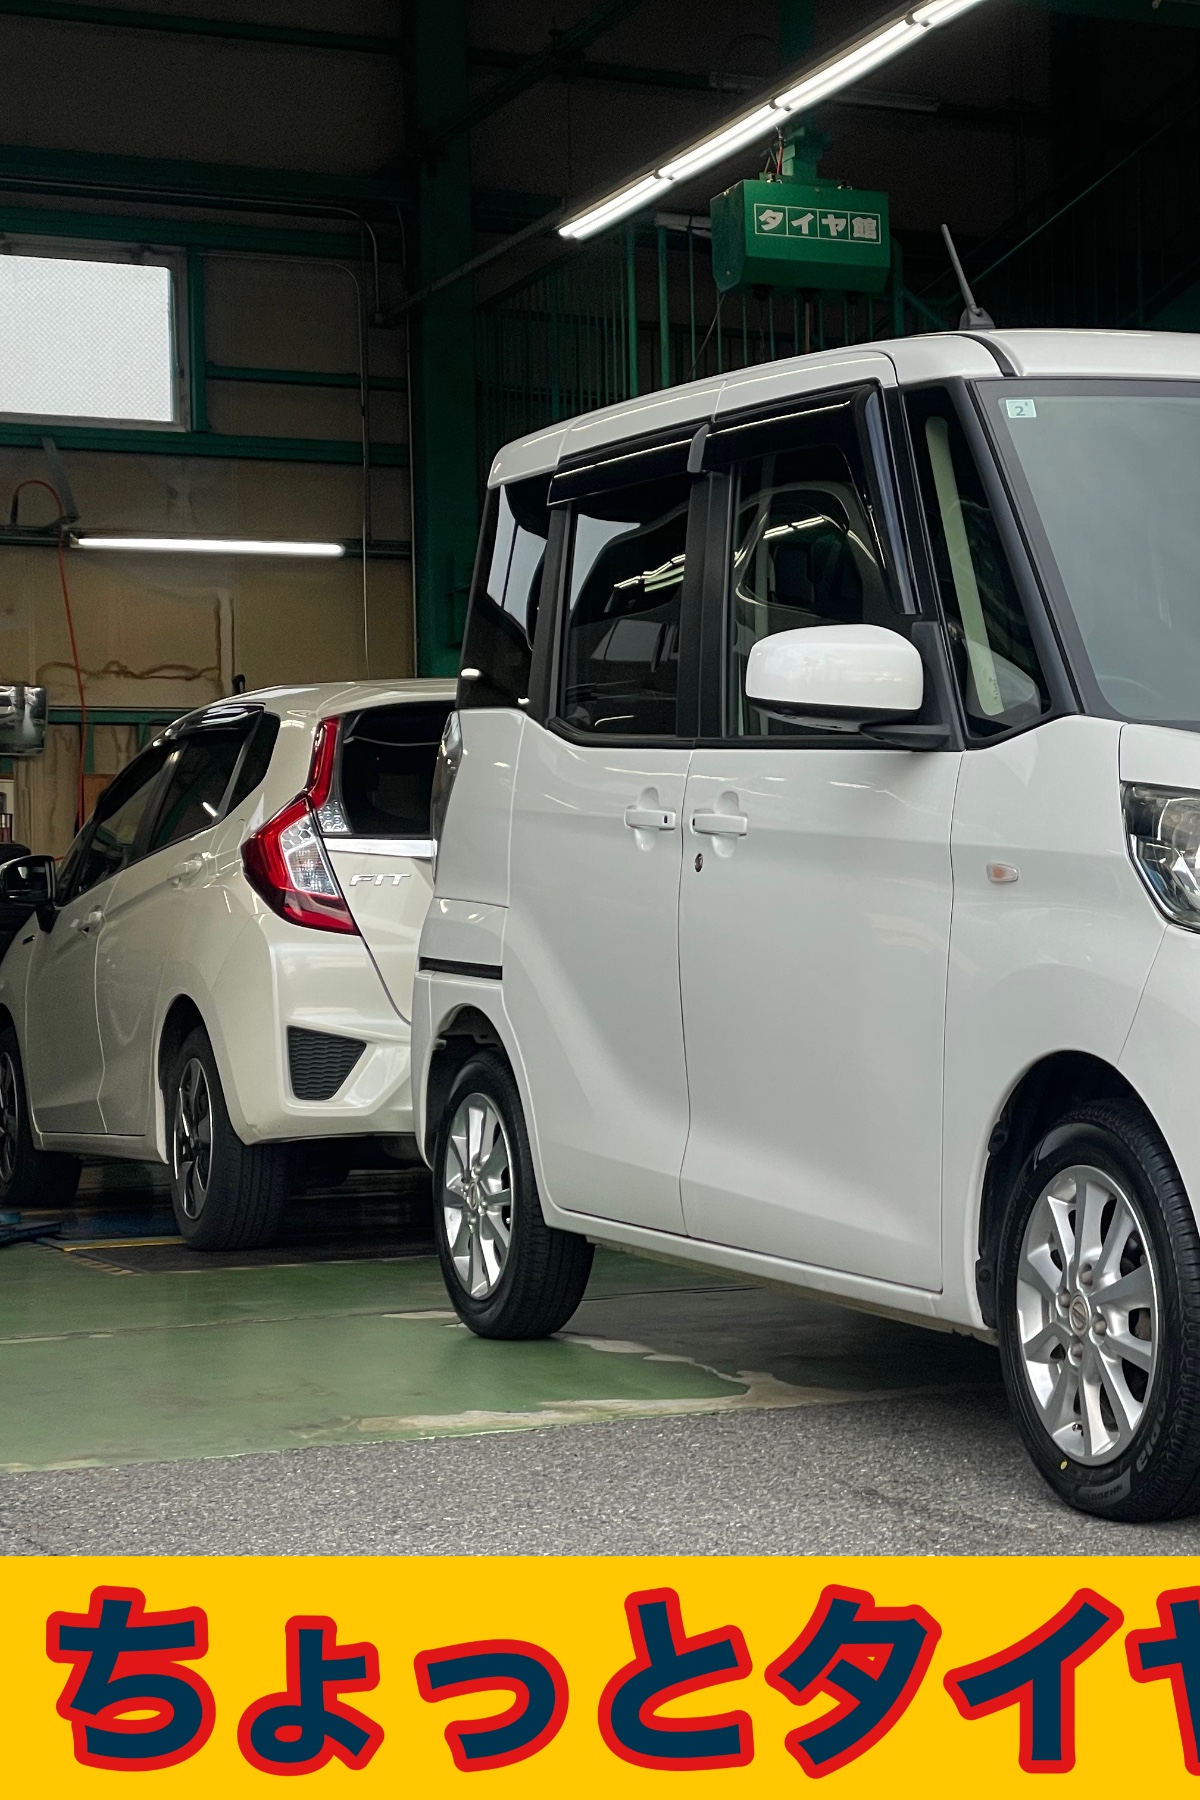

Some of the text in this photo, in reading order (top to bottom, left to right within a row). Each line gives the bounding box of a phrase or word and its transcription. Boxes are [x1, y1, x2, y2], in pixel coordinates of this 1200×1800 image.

[758, 209, 877, 240] タイヤ館
[1014, 406, 1026, 416] 2
[349, 873, 411, 886] FIT
